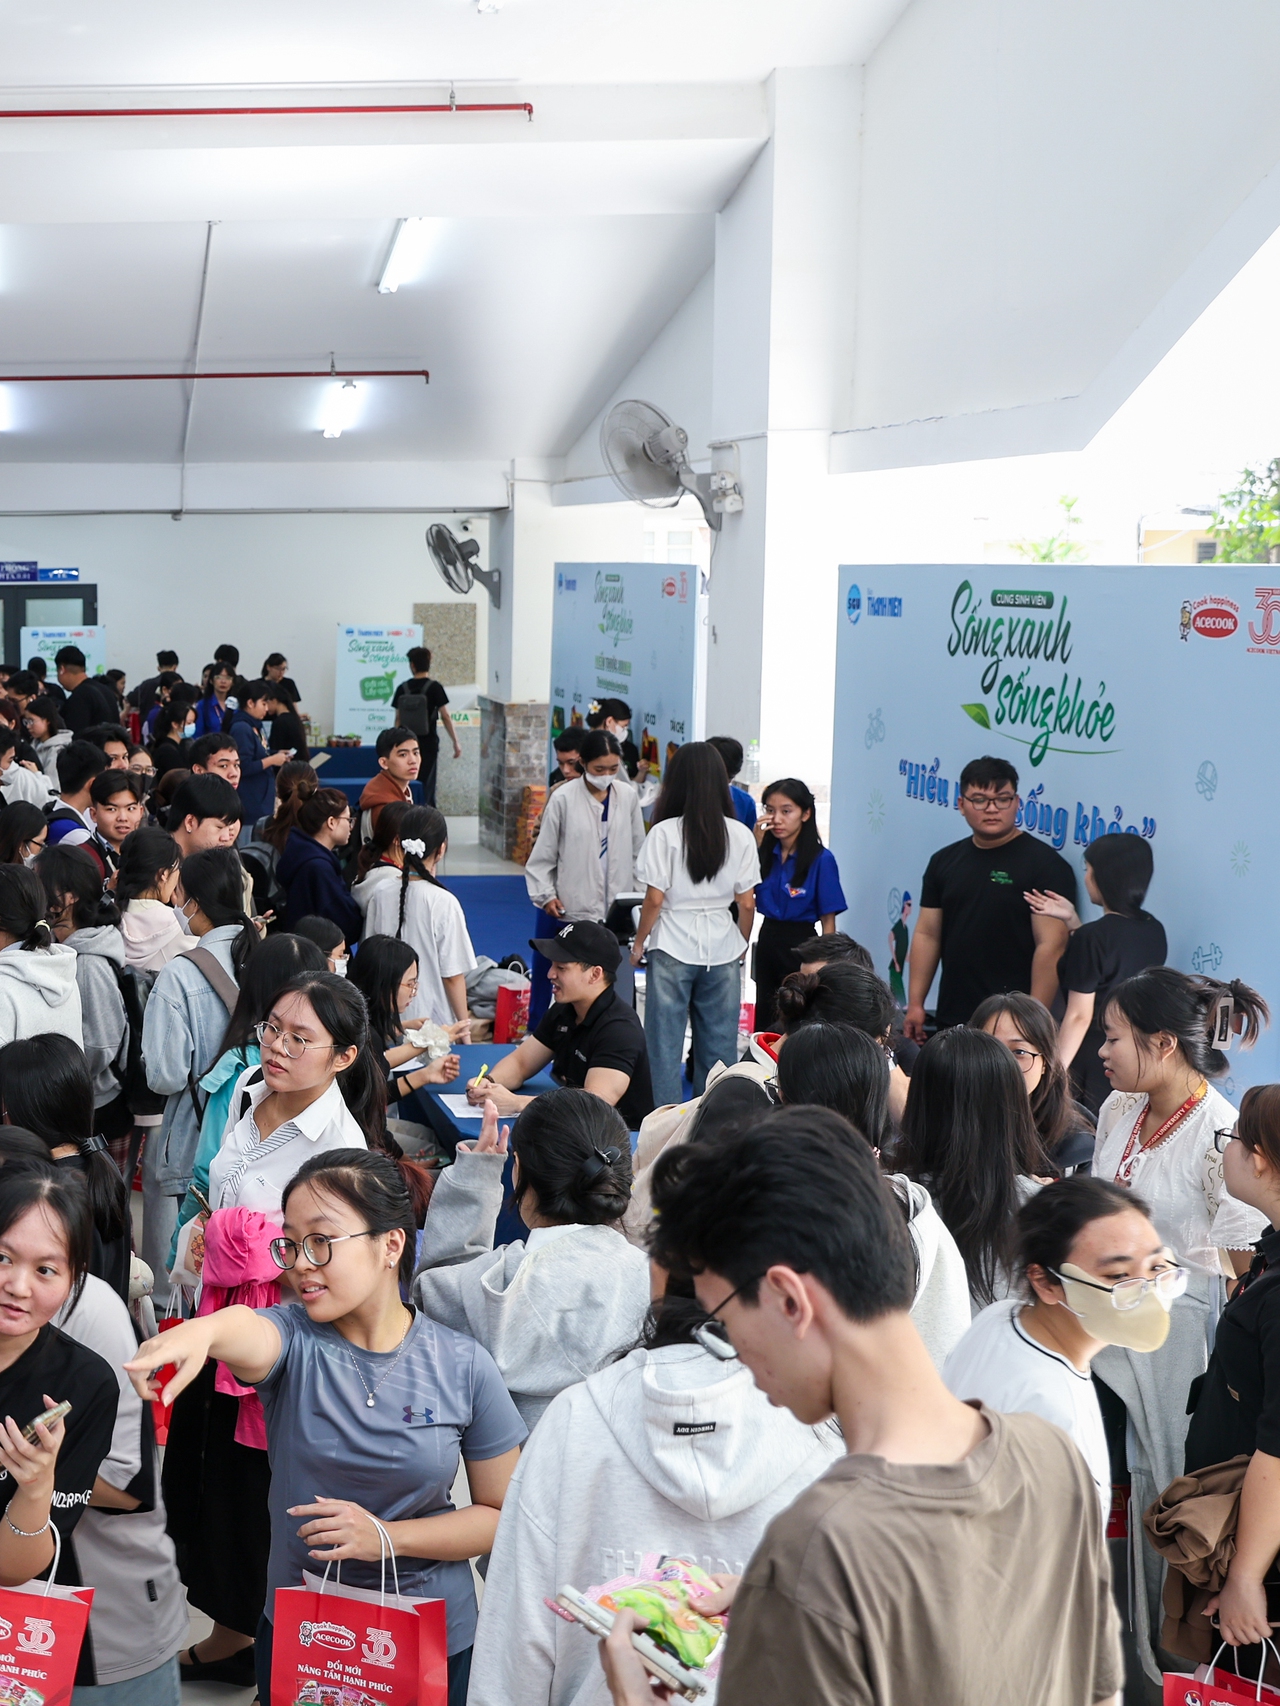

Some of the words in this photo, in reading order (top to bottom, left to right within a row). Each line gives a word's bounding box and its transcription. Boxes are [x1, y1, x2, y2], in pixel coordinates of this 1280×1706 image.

[847, 598, 861, 610] SGU
[1015, 593, 1030, 605] SINH
[1193, 596, 1208, 610] Cook
[1209, 595, 1239, 613] happiness
[947, 580, 1006, 695] Sống
[1003, 595, 1073, 664] xanh
[995, 666, 1055, 767] sống
[1053, 673, 1116, 742] khỏe
[1158, 1108, 1187, 1136] UNIVERSITY
[313, 1622, 327, 1630] Cook
[328, 1622, 356, 1639] happiness
[21, 1667, 48, 1680] PHÚC
[327, 1660, 343, 1671] ĐỔI
[345, 1665, 362, 1676] MỚI
[297, 1664, 321, 1676] NÂNG
[323, 1669, 341, 1681] TẦM
[343, 1675, 367, 1688] HẠNH
[368, 1679, 393, 1693] PHÚC
